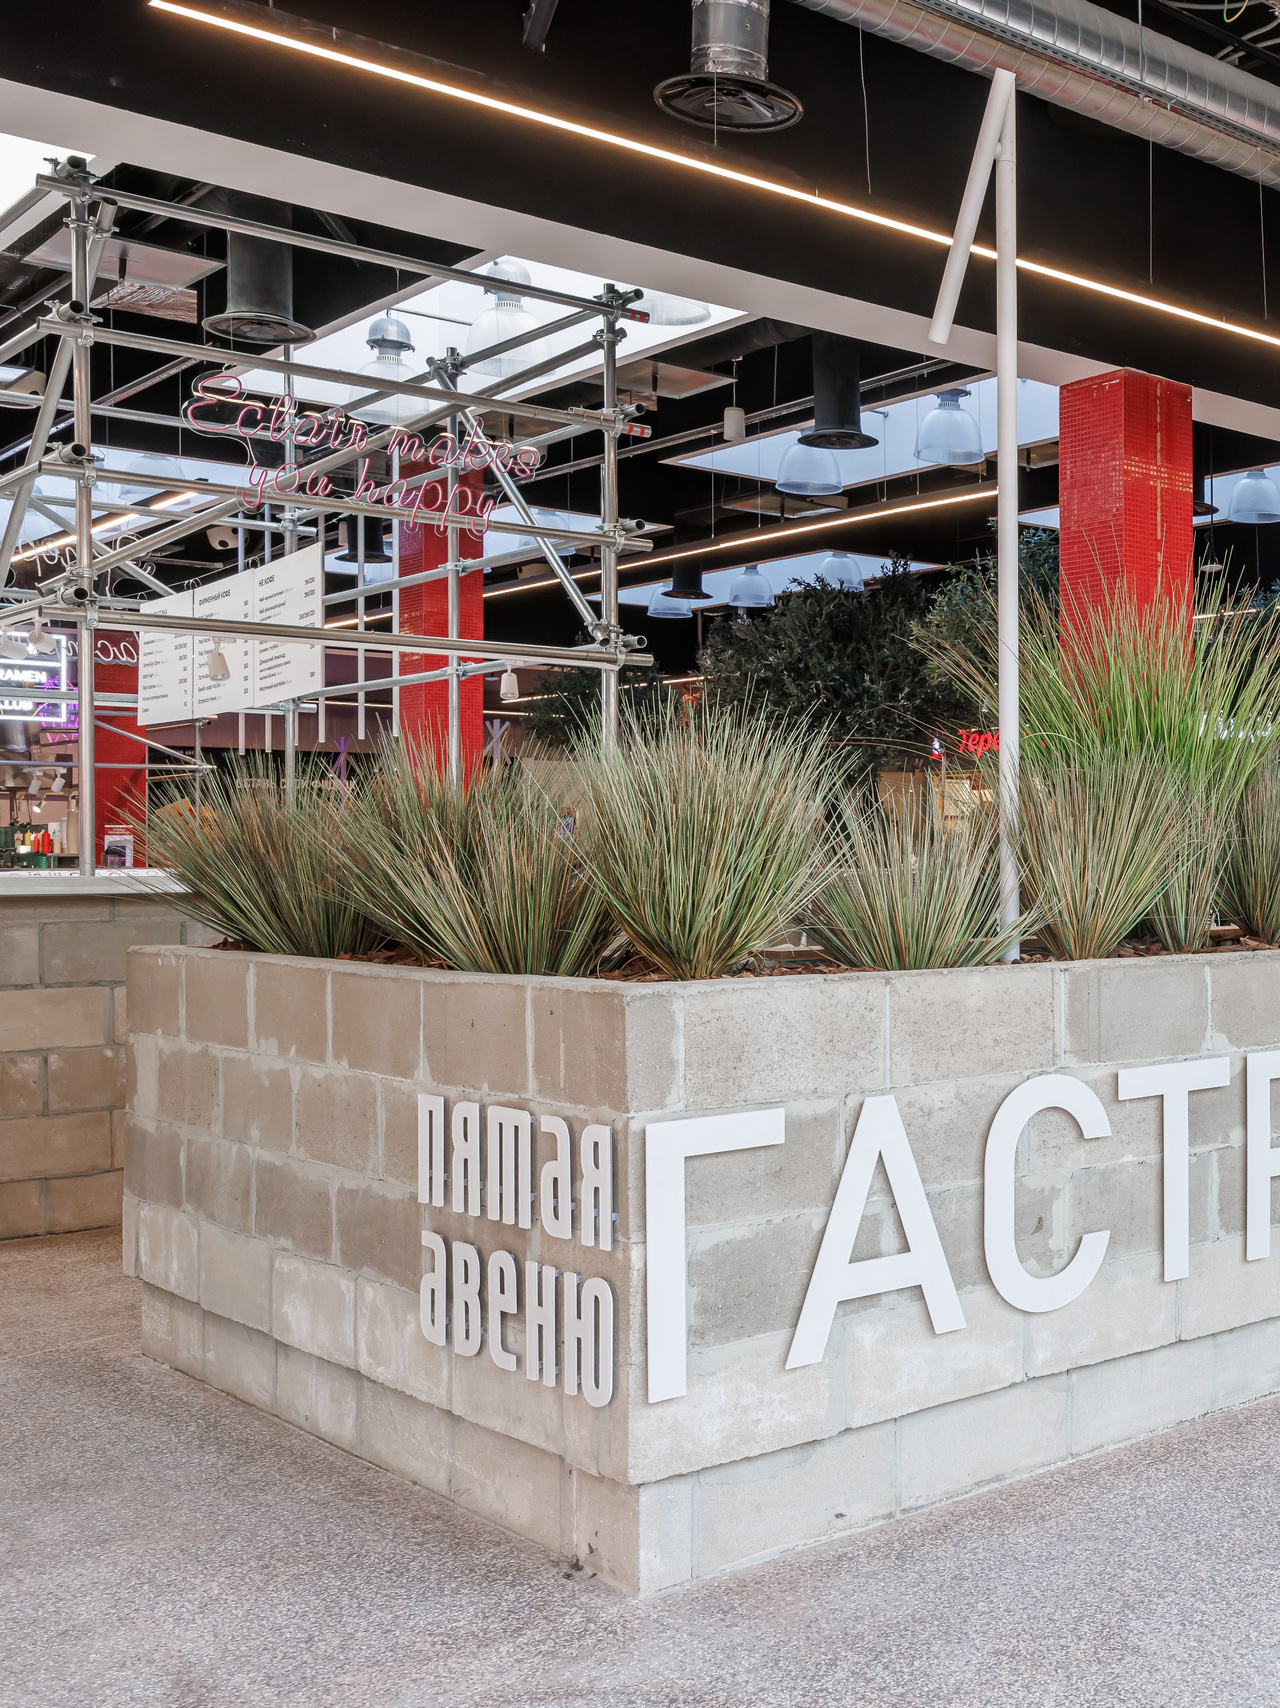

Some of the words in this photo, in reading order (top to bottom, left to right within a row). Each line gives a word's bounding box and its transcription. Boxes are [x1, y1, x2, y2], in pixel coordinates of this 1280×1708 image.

[187, 375, 369, 452] Eclair
[387, 416, 538, 477] makes
[241, 460, 334, 509] you
[354, 456, 495, 536] happy
[0, 668, 47, 684] RAMEN
